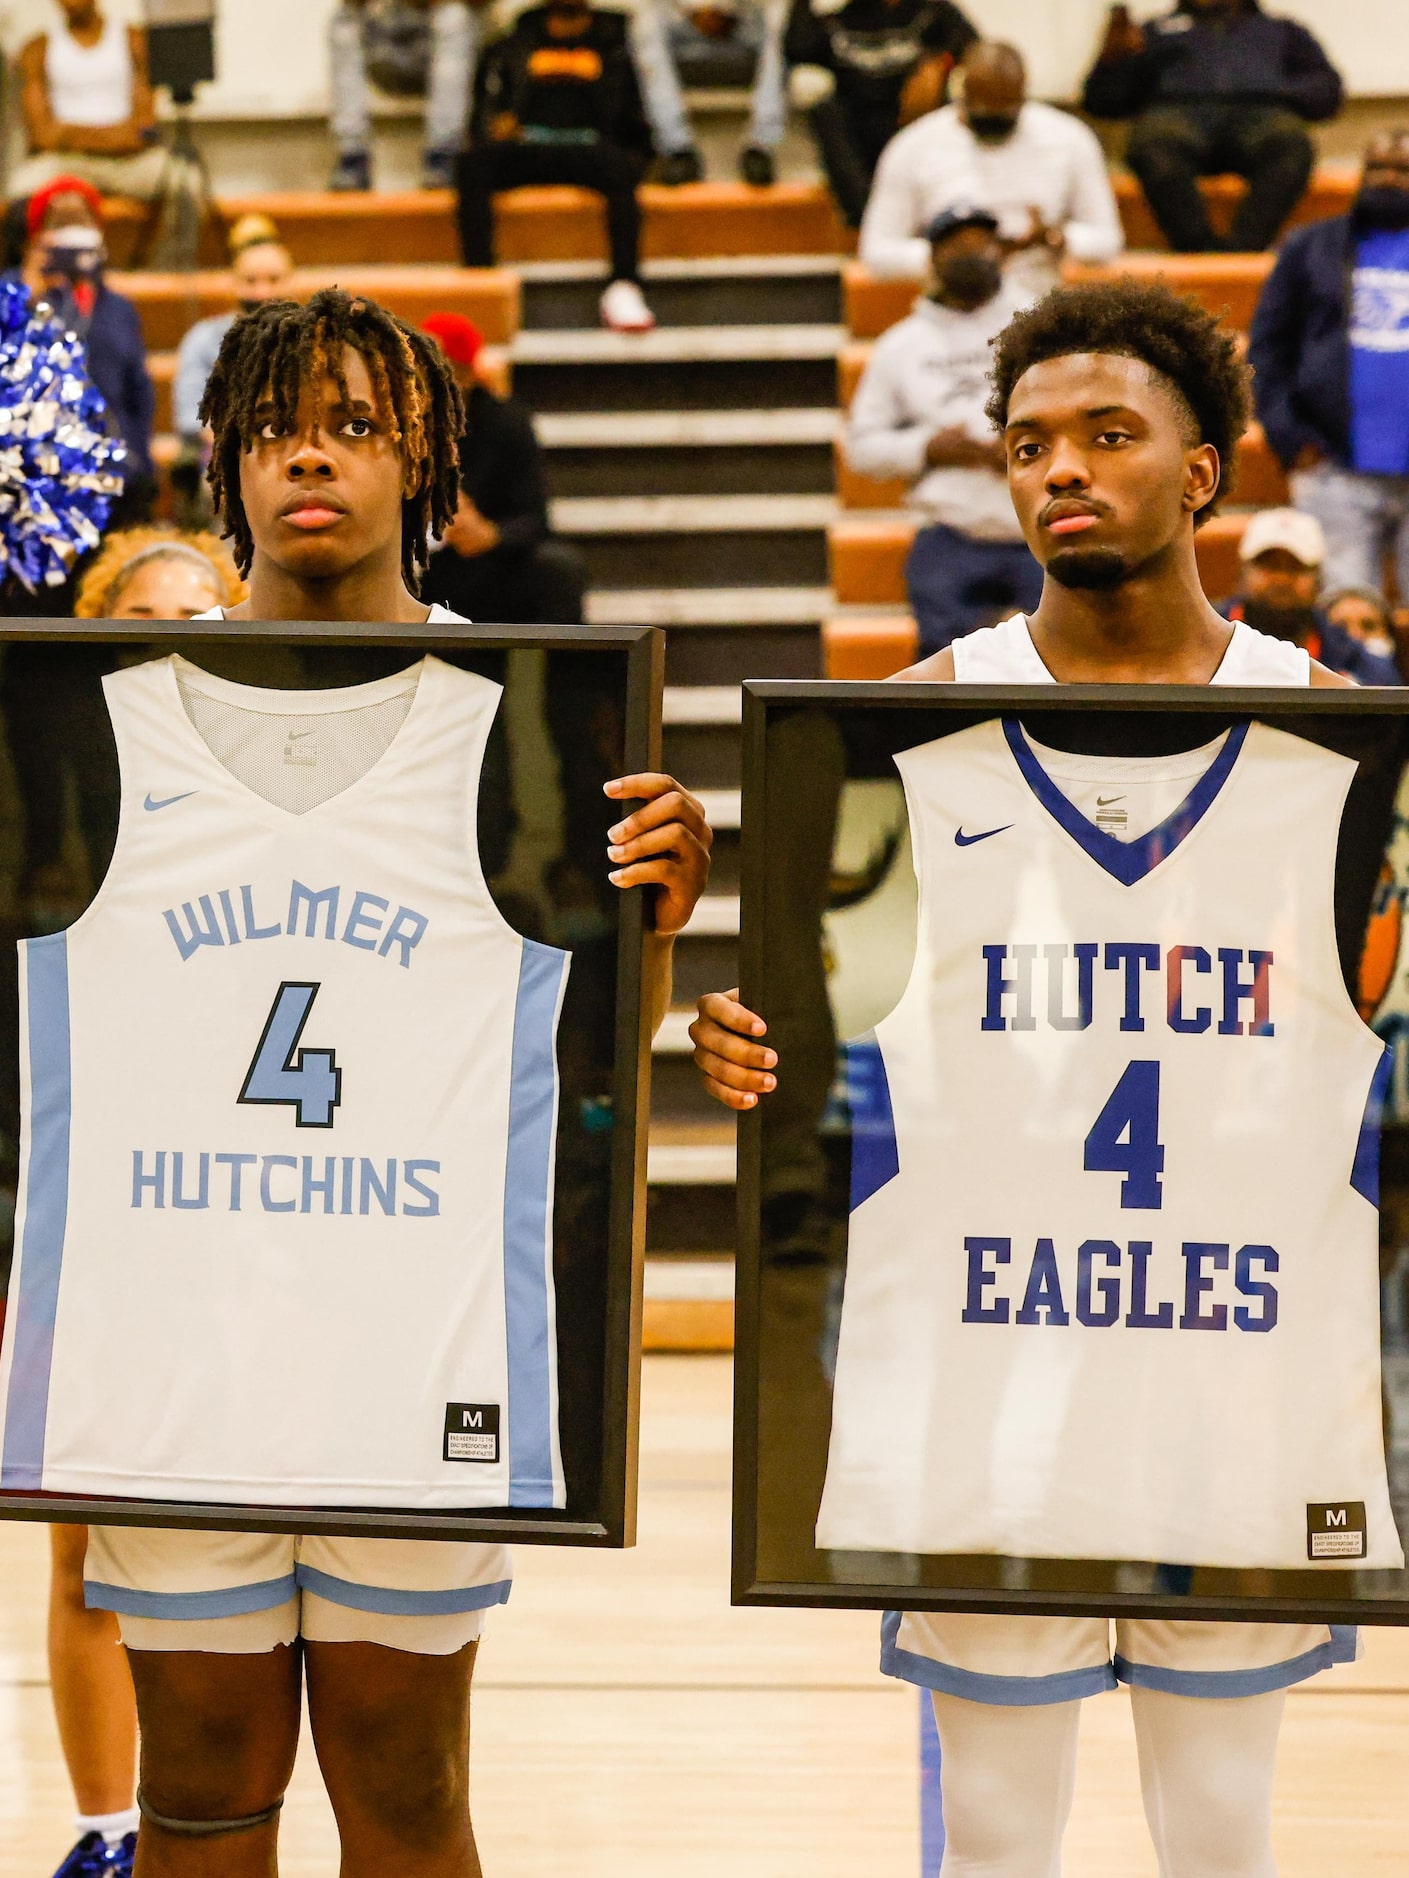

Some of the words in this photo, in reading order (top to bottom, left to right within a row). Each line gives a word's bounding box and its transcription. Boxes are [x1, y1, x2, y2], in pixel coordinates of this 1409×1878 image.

[162, 880, 428, 968] WILMER
[981, 943, 1274, 1037] HUTCH
[235, 980, 343, 1129] 4
[1083, 1060, 1165, 1210] 4
[131, 1151, 440, 1216] HUTCHINS
[962, 1236, 1280, 1332] EAGLES
[463, 1411, 483, 1428] M
[1326, 1510, 1347, 1526] M
